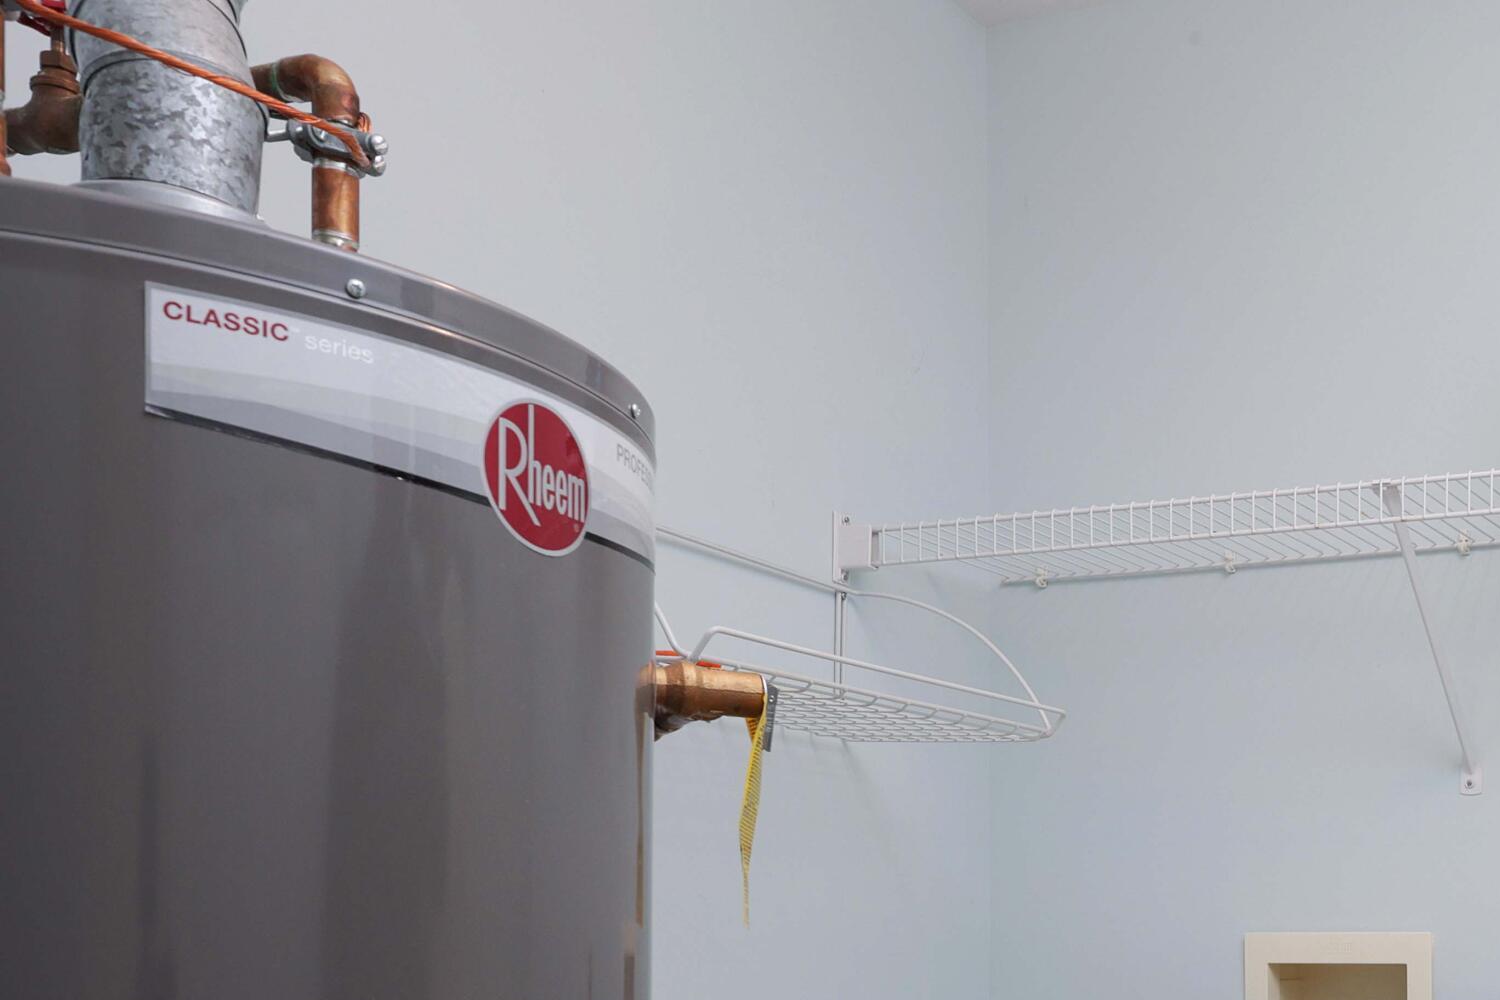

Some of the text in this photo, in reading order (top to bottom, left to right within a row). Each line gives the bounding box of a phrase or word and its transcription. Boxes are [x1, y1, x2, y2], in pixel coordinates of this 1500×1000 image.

[163, 301, 374, 364] CLASSIC series
[498, 404, 585, 527] Rheem
[616, 443, 654, 489] PROFES
